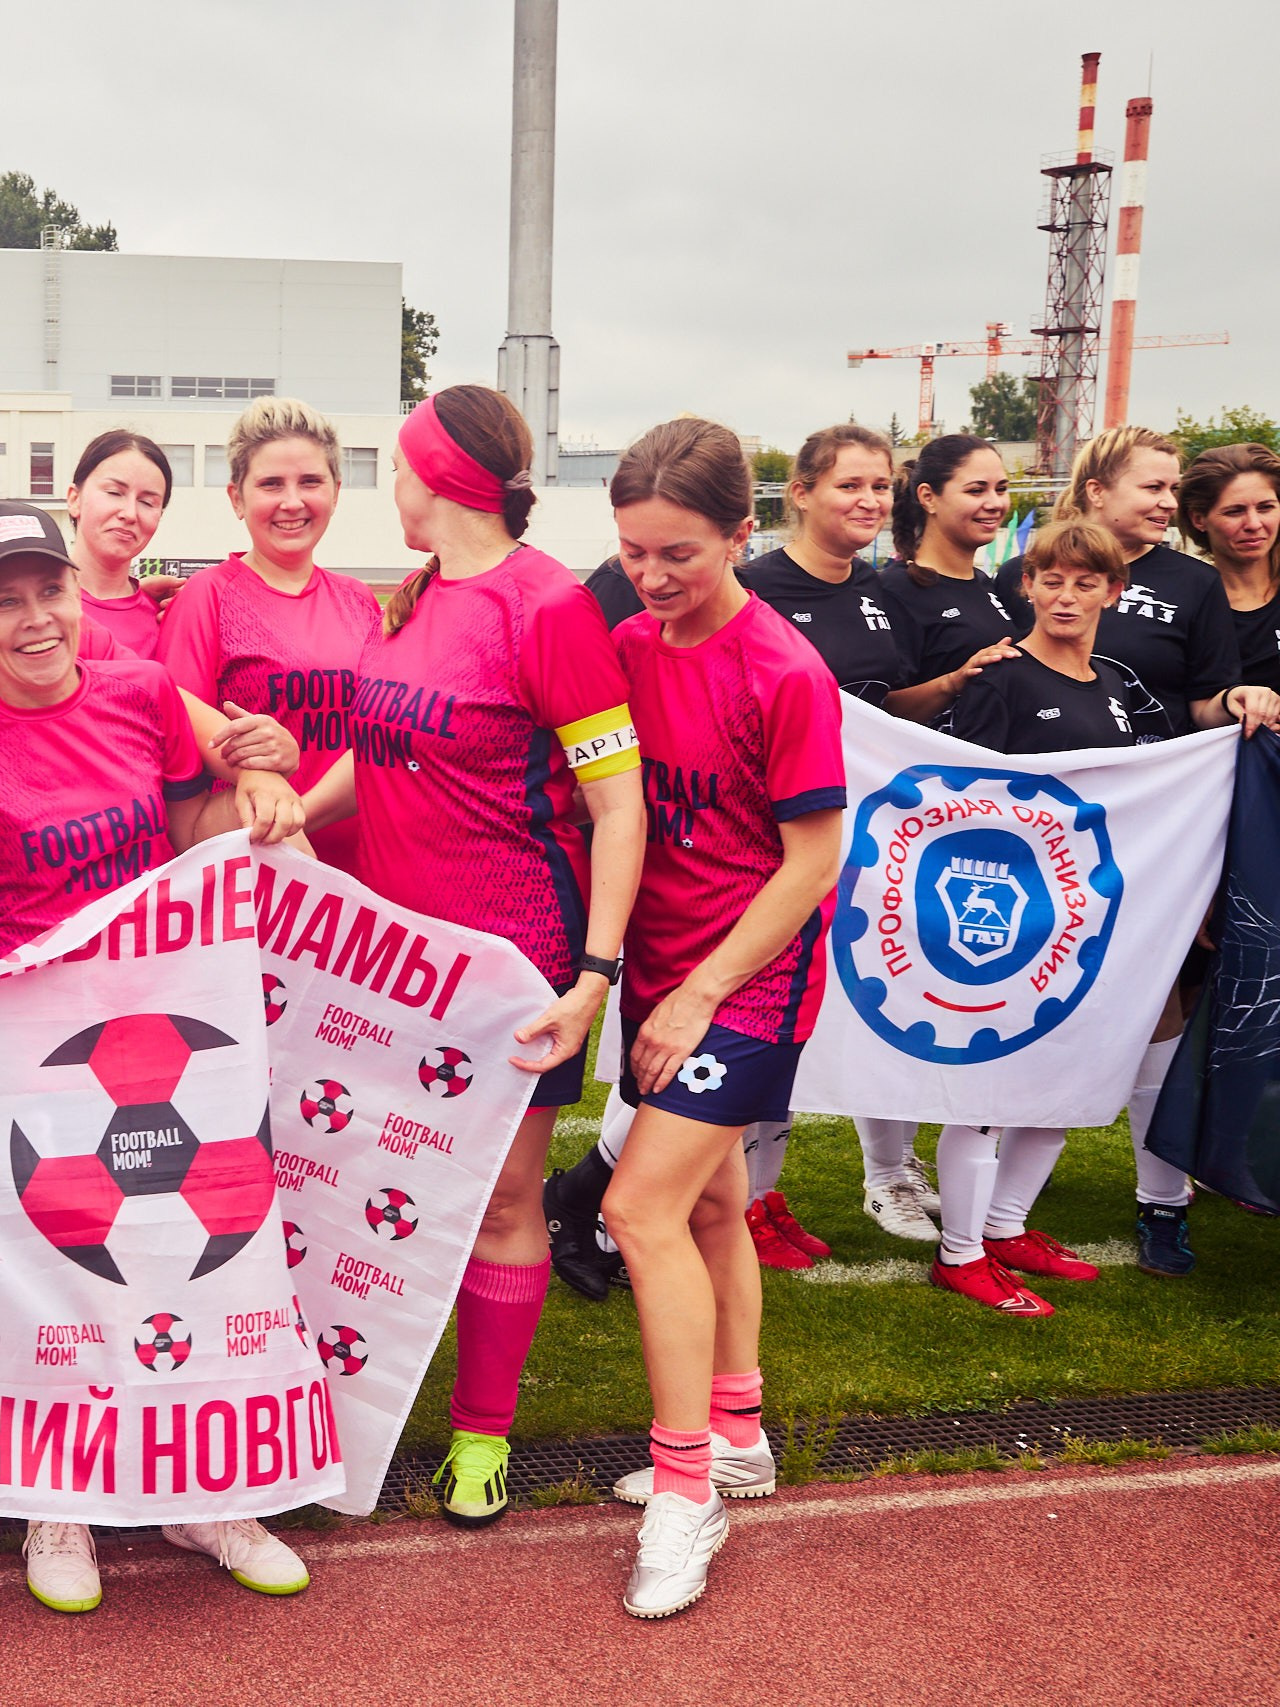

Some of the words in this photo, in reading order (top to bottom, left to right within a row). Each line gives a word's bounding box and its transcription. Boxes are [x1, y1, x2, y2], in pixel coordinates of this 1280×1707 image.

[1117, 600, 1176, 624] ГАЗ
[349, 676, 457, 740] OOTBALL
[878, 798, 1003, 978] ПРОФСОЮЗНАЯ
[1011, 805, 1087, 993] ОРГАНИЗАЦИЯ
[253, 862, 472, 1022] МАМЫ
[963, 929, 1004, 946] ГАЗ
[315, 1022, 358, 1052] MOM!
[322, 1003, 394, 1047] FOOTBALL
[111, 1127, 183, 1152] FOOTBALL
[377, 1130, 420, 1160] MOM!
[384, 1112, 455, 1154] FOOTBALL
[113, 1149, 152, 1171] MOM!
[330, 1270, 370, 1300] MOM!
[336, 1252, 405, 1296] FOOTBALL
[37, 1324, 105, 1345] FOOTBALL
[226, 1308, 290, 1335] FOOTBALL
